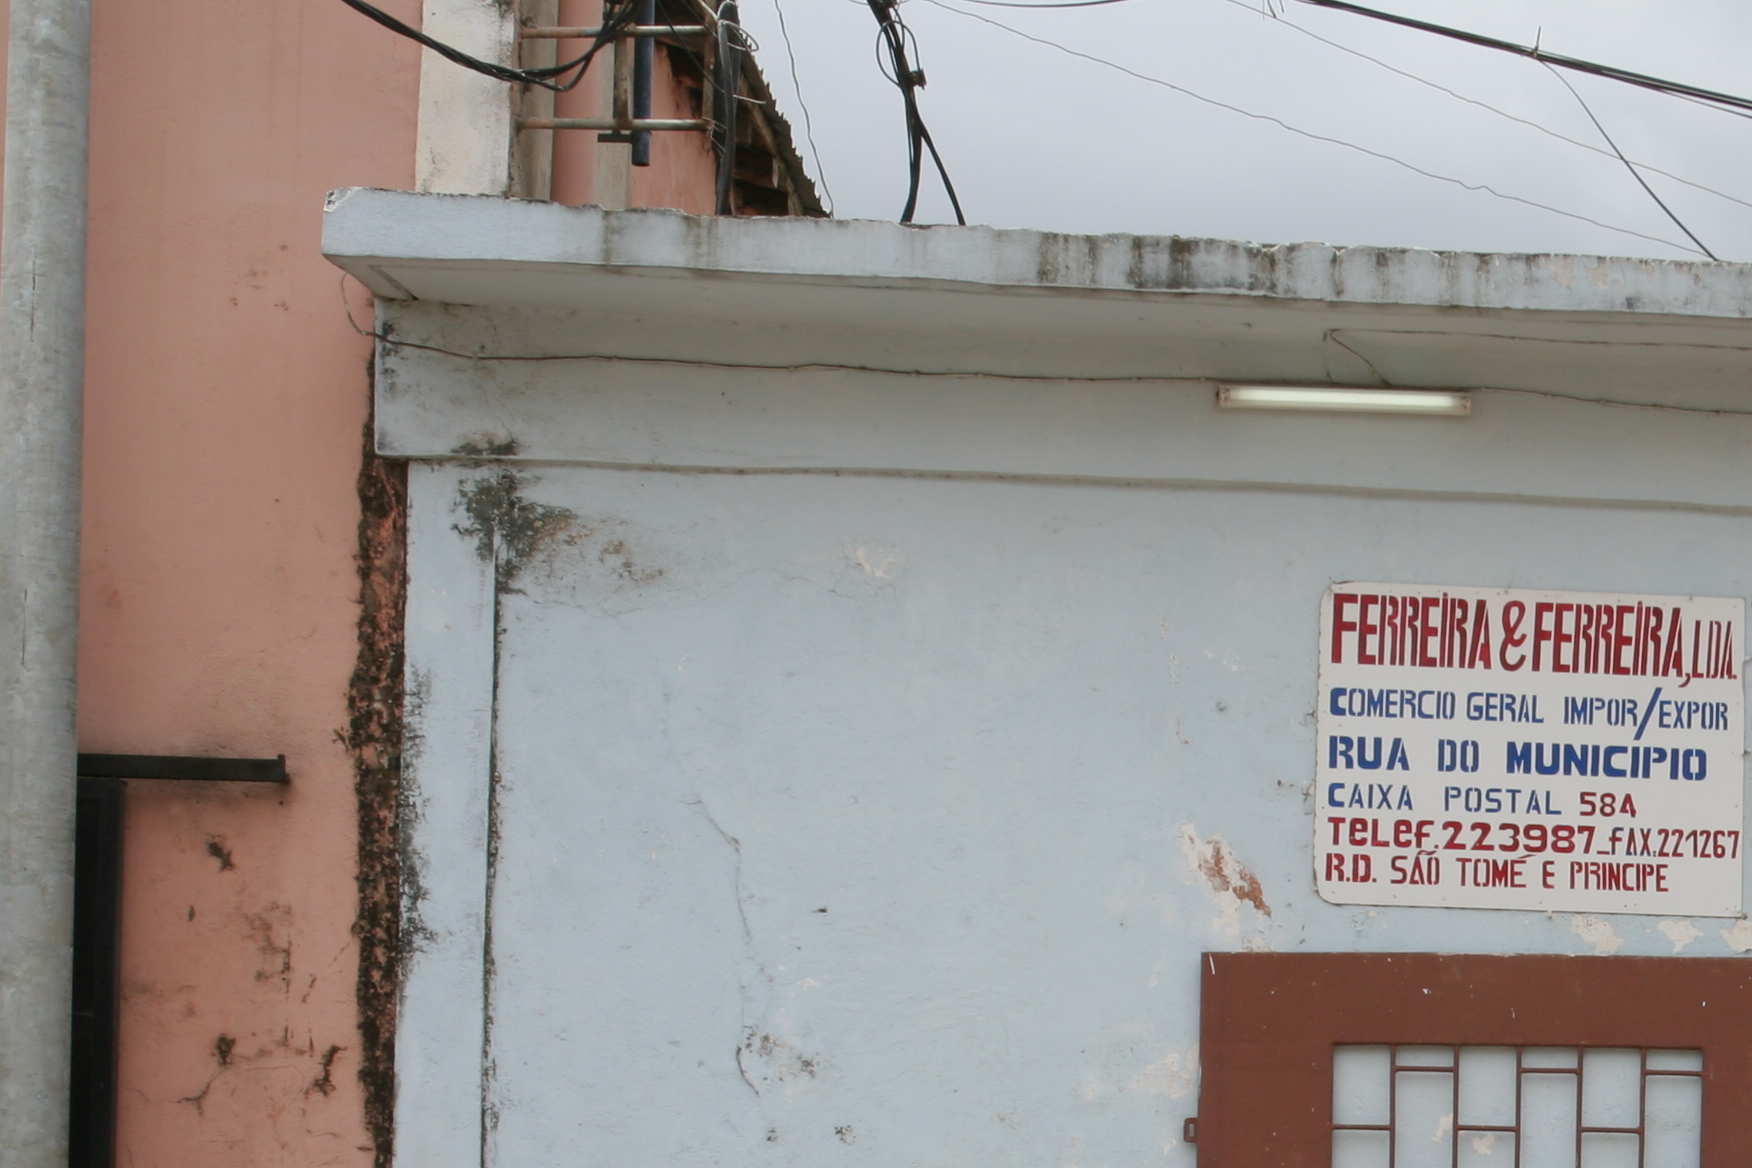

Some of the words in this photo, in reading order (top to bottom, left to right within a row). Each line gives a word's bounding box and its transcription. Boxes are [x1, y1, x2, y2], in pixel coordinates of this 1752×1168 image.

[1331, 592, 1492, 670] FERREIRA
[1500, 601, 1527, 672] &
[1330, 687, 1456, 720] COMERCIO
[1466, 692, 1544, 723] GERAL
[1329, 736, 1410, 771] RUA
[1437, 739, 1479, 773] DO
[1506, 741, 1707, 781] MUNICIPIO
[1328, 782, 1414, 811] CAIXA
[1444, 786, 1562, 815] POSTAL
[1579, 791, 1637, 818] 58A
[1325, 853, 1377, 883] R.D.
[1390, 850, 1440, 885] SÃO
[1455, 854, 1538, 888] TOMÉ
[1542, 860, 1555, 890] E
[1569, 861, 1669, 893] PRINCIPE
